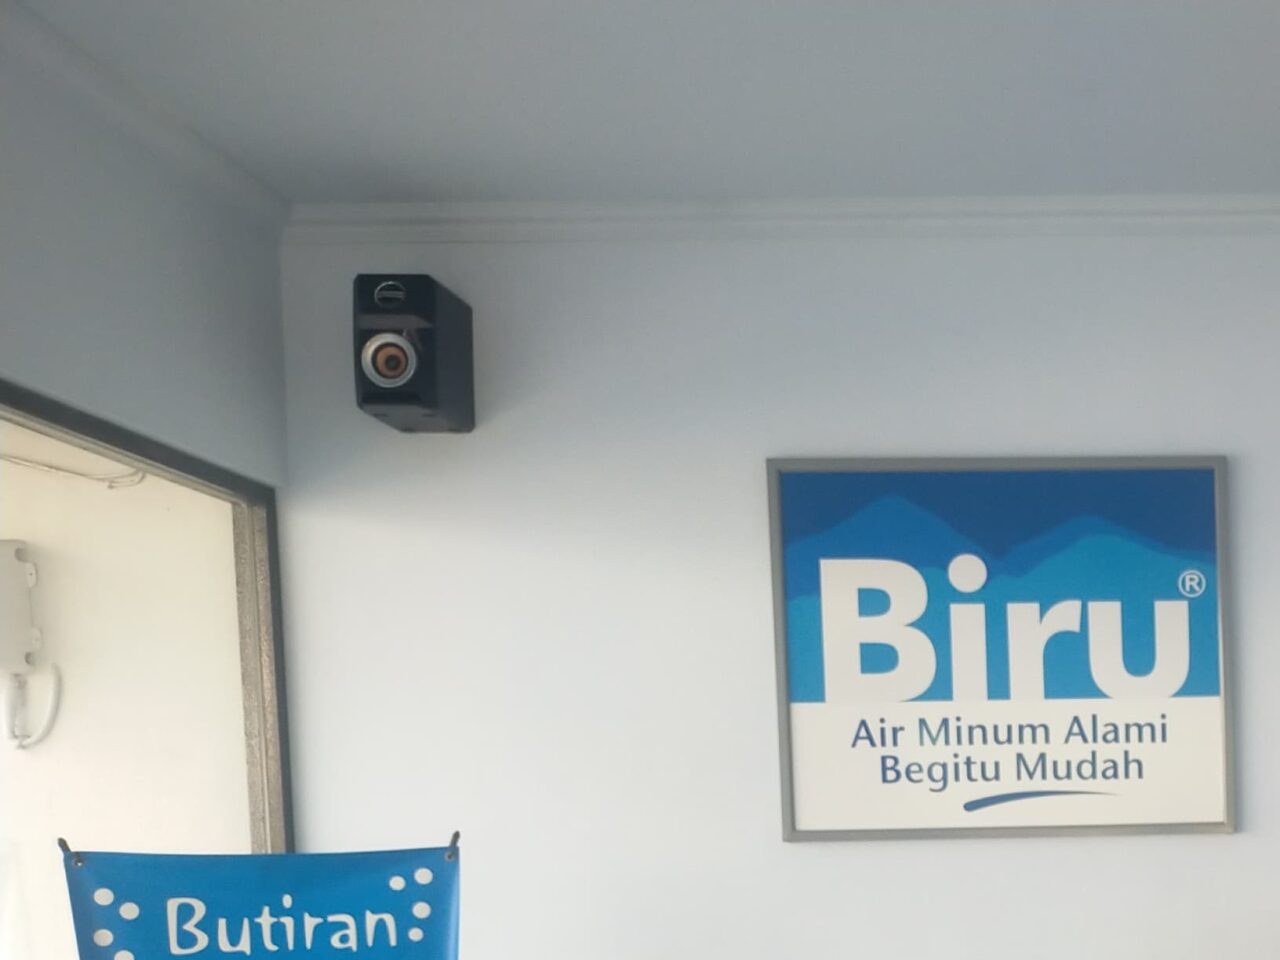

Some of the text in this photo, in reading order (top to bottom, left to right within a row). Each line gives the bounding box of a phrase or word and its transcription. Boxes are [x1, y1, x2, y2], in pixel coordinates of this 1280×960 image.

[818, 553, 1190, 702] Biru
[850, 713, 1168, 748] Air Minum Alami
[880, 749, 1144, 793] Begitu Mudah
[165, 894, 398, 955] Butiran
